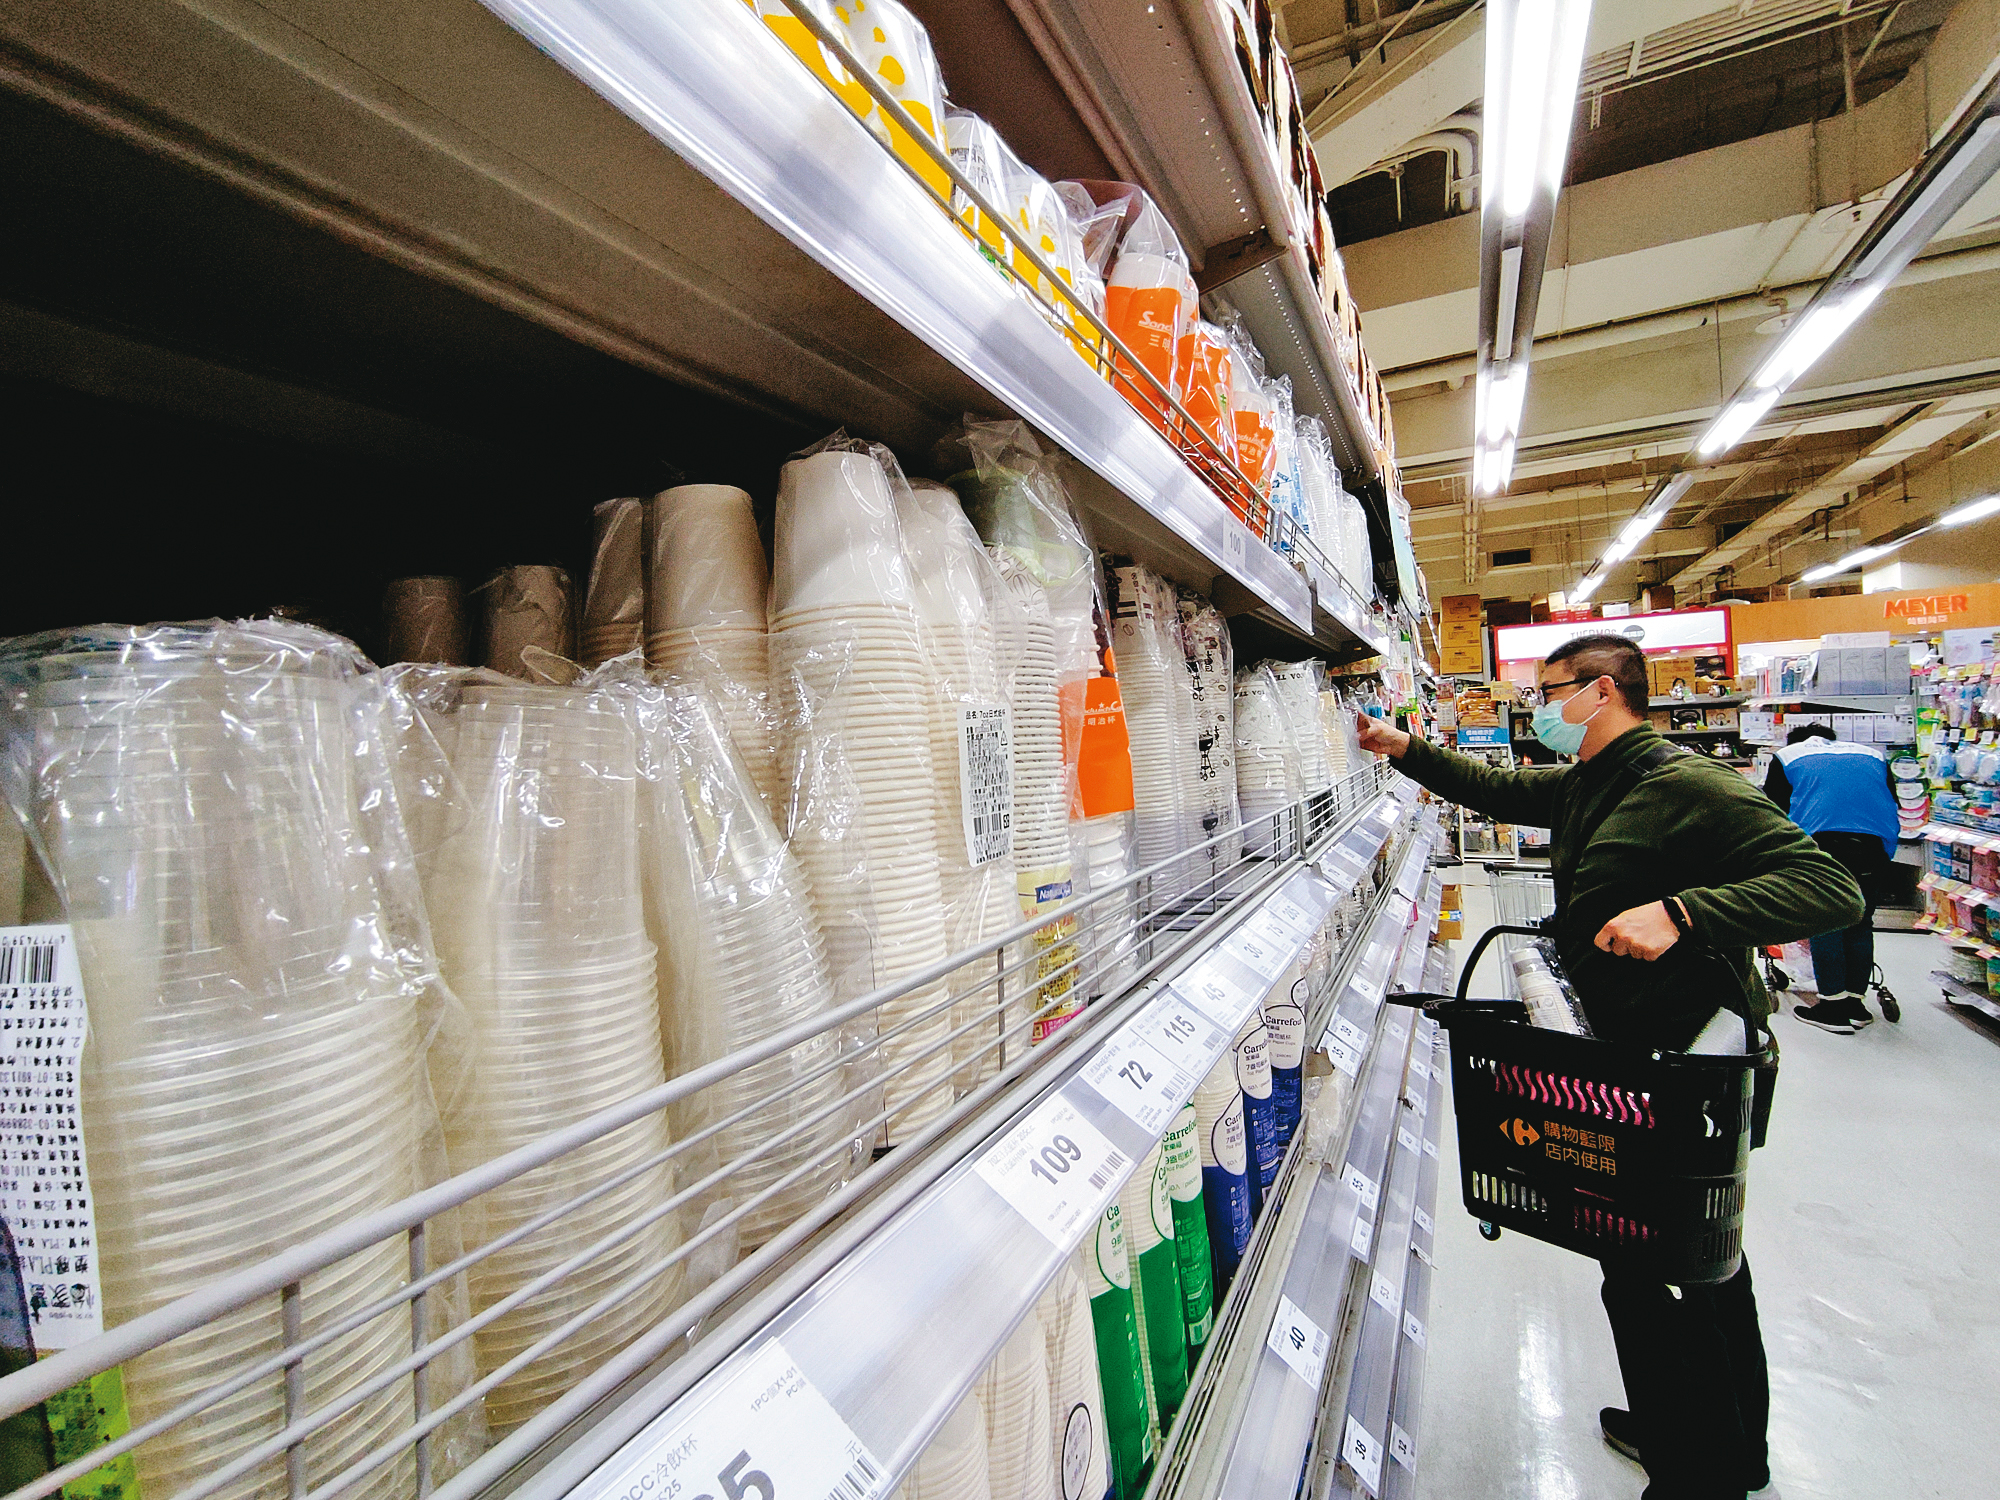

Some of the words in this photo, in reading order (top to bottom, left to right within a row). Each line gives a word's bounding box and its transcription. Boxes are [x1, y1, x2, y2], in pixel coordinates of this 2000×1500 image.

[1229, 531, 1241, 555] 100
[1883, 594, 1968, 619] MEYER
[1243, 942, 1263, 959] 38
[1202, 983, 1226, 1001] 45
[1163, 1014, 1196, 1045] 115
[1332, 1046, 1345, 1059] 35
[1117, 1060, 1153, 1090] 72
[1029, 1134, 1082, 1186] 109
[1545, 1142, 1617, 1176] 店內使用
[1352, 1178, 1364, 1191] 55
[1289, 1326, 1306, 1350] 40
[844, 1440, 863, 1461] 元
[1354, 1439, 1367, 1460] 38
[1398, 1439, 1407, 1455] 32
[691, 1449, 776, 1500] 5
